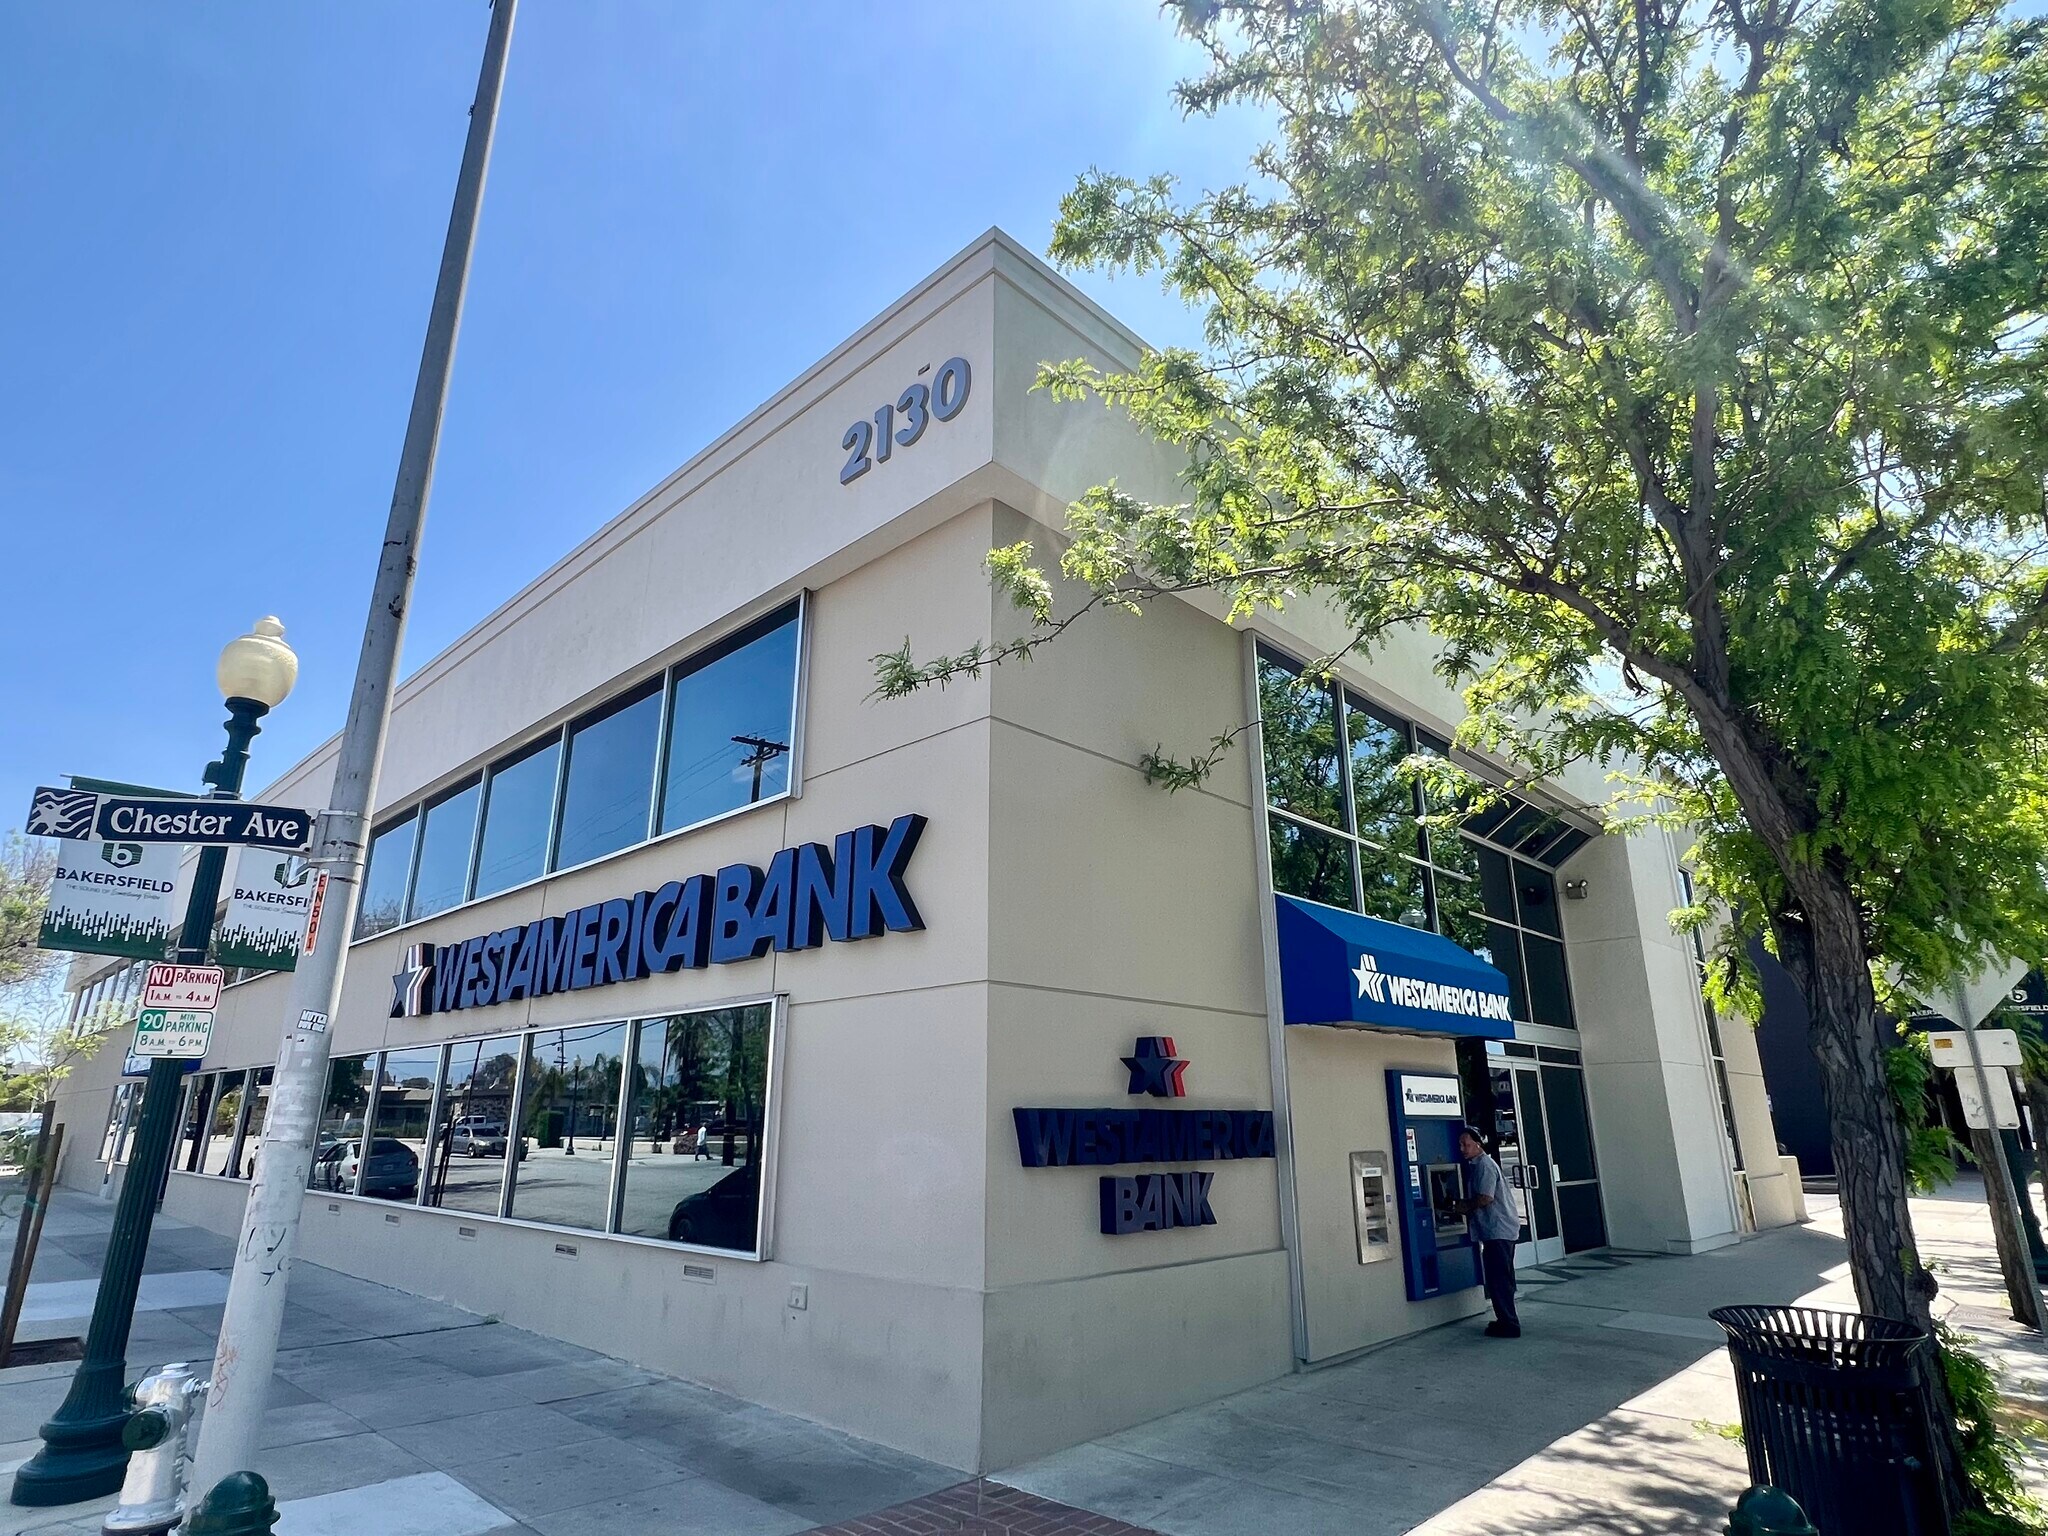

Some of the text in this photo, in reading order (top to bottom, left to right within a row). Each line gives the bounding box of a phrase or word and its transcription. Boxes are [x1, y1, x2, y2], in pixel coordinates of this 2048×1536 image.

[840, 357, 972, 486] 2130
[110, 806, 299, 841] Chester Ave
[56, 867, 174, 893] BAKERSFIELD
[234, 888, 308, 908] BAKERSFI
[434, 812, 929, 1012] WESTAMERICA BANK
[150, 967, 219, 985] NO PARKING
[1387, 974, 1513, 1022] WESTAMERICA BANK
[142, 1013, 197, 1029] 90 MIN
[165, 1021, 209, 1034] PARKING
[1013, 1107, 1276, 1167] WESTAMERICA
[1099, 1171, 1217, 1235] BANK
